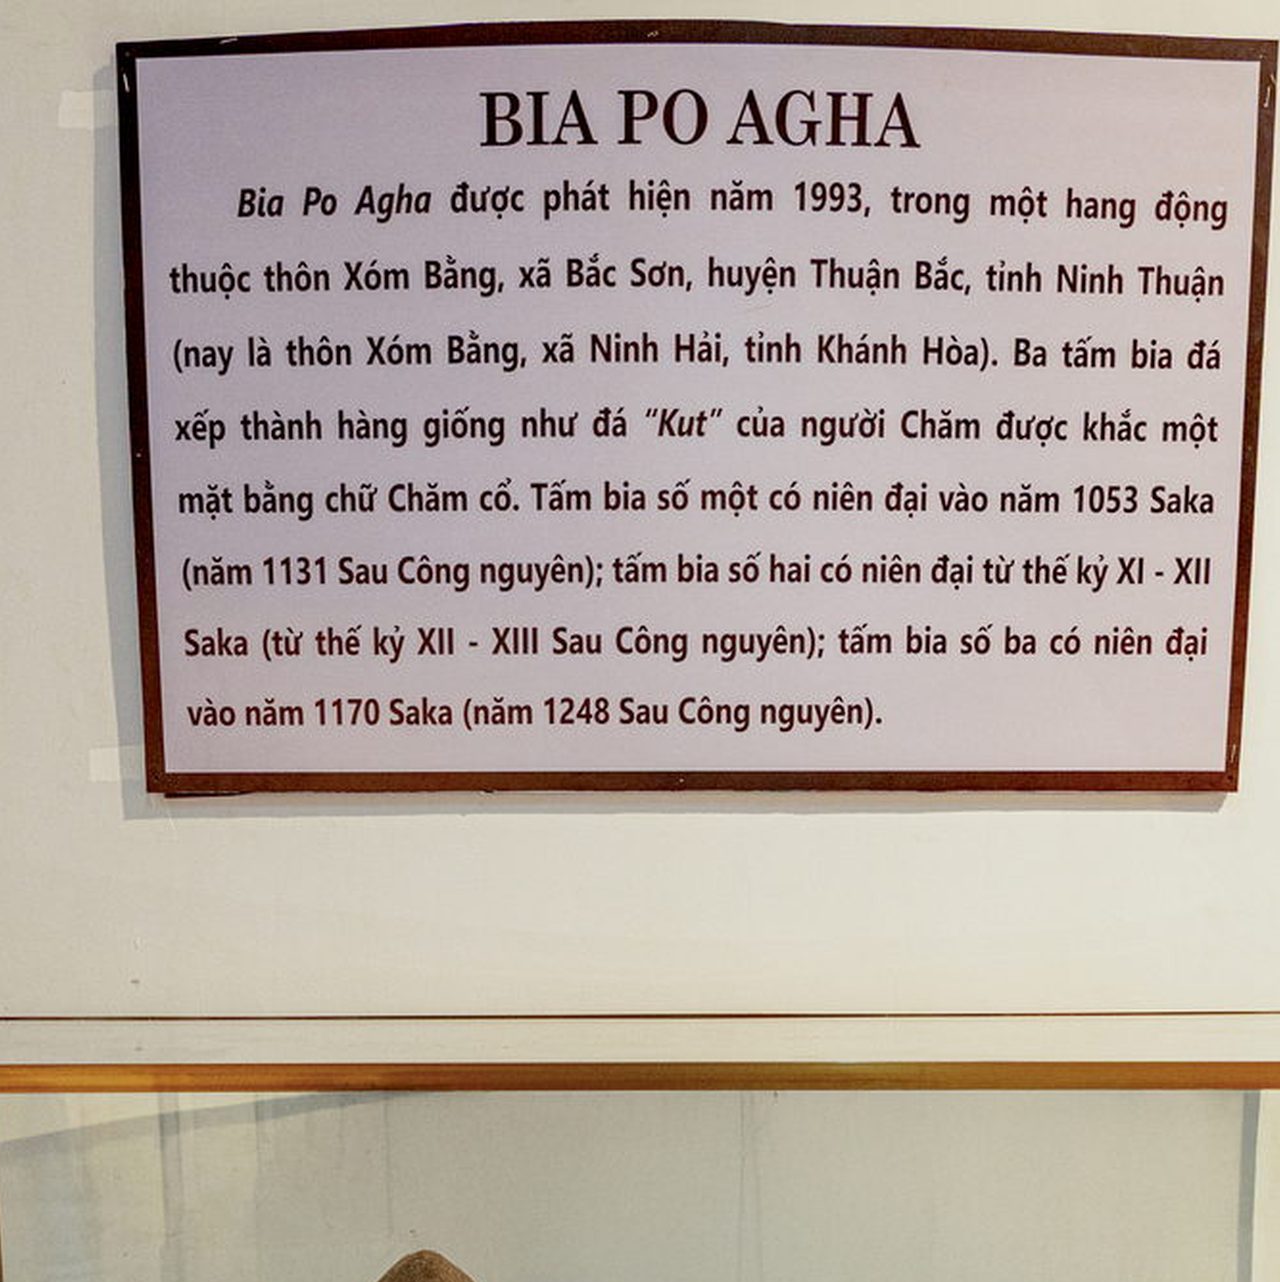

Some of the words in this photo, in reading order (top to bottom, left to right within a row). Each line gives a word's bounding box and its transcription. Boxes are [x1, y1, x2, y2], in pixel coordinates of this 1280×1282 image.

[477, 88, 600, 149] BIA
[615, 87, 710, 147] PO
[724, 87, 923, 150] AGHA
[235, 184, 286, 220] Bia
[301, 184, 339, 218] Po
[352, 181, 433, 226] Agha
[448, 179, 526, 221] được
[542, 178, 612, 222] phát
[627, 177, 692, 220] hiện
[709, 178, 774, 213] năm
[793, 179, 872, 219] 1993,
[889, 184, 971, 226] trong
[988, 184, 1049, 226] một
[1065, 186, 1137, 230] hang
[1153, 188, 1229, 232] động
[167, 260, 253, 302] thuộc
[261, 259, 332, 294] thôn
[342, 257, 411, 293] Xóm
[423, 253, 506, 299] Bằng,
[517, 256, 553, 290] xã
[565, 251, 618, 289] Bắc
[629, 256, 694, 294] Sơn,
[707, 254, 797, 298] huyện
[808, 255, 901, 298] Thuận
[914, 254, 972, 297] Bắc,
[984, 258, 1043, 294] tỉnh
[1055, 262, 1125, 296] Ninh
[1136, 263, 1225, 304] Thuận
[172, 337, 236, 378] (nay
[246, 334, 273, 369] là
[283, 333, 354, 368] thôn
[364, 332, 433, 367] Xóm
[446, 328, 528, 374] Bằng,
[540, 331, 576, 365] xã
[589, 330, 660, 364] Ninh
[673, 329, 730, 369] Hải,
[743, 329, 803, 365] tỉnh
[816, 331, 908, 366] Khánh
[922, 333, 999, 373] Hòa).
[1012, 336, 1048, 369] Ba
[1060, 334, 1117, 370] tấm
[1130, 337, 1174, 371] bia
[1186, 338, 1222, 371] đá
[173, 406, 228, 451] xếp
[238, 408, 324, 442] thành
[336, 407, 409, 450] hàng
[422, 404, 506, 449] giống
[520, 405, 580, 439] như
[591, 405, 628, 439] đá
[735, 404, 786, 439] của
[800, 406, 886, 448] người
[899, 407, 982, 441] Chăm
[995, 408, 1069, 449] được
[1081, 407, 1149, 443] khắc
[1161, 411, 1220, 451] một
[177, 482, 235, 522] mặt
[242, 478, 315, 523] bằng
[323, 481, 380, 515] chữ
[386, 480, 469, 514] Chăm
[478, 475, 521, 513] cổ.
[528, 477, 593, 513] Tấm
[602, 479, 647, 513] bia
[656, 477, 692, 512] số
[699, 479, 760, 519] một
[767, 479, 803, 512] có
[812, 480, 874, 513] niên
[883, 480, 929, 520] đại
[937, 481, 990, 514] vào
[999, 482, 1061, 514] năm
[1072, 483, 1139, 515] 1053
[1149, 483, 1215, 515] Saka
[181, 554, 254, 593] (năm
[261, 554, 327, 587] 1131
[337, 555, 389, 587] Sau
[396, 553, 471, 594] Công
[478, 552, 604, 594] nguyên);
[610, 550, 668, 585] tấm
[676, 551, 720, 584] bia
[727, 550, 763, 585] số
[768, 551, 812, 584] hai
[819, 552, 854, 585] có
[861, 552, 922, 585] niên
[930, 553, 975, 592] đại
[981, 553, 1017, 586] từ
[1020, 552, 1072, 586] thế
[1075, 553, 1110, 594] kỷ
[1115, 555, 1146, 586] XI
[1172, 556, 1212, 586] XII
[183, 625, 250, 659] Saka
[261, 625, 305, 664] (từ
[313, 623, 364, 658] thế
[372, 623, 407, 665] kỷ
[416, 626, 455, 657] XII
[490, 625, 540, 656] XIII
[551, 625, 603, 656] Sau
[614, 623, 689, 664] Công
[701, 623, 826, 664] nguyên);
[836, 622, 893, 656] tấm
[905, 623, 948, 656] bia
[959, 622, 994, 656] số
[1003, 624, 1038, 656] ba
[1048, 624, 1082, 656] có
[1093, 625, 1153, 657] niên
[1164, 625, 1209, 663] đại
[185, 696, 238, 728] vào
[243, 696, 306, 728] năm
[313, 696, 382, 727] 1170
[388, 695, 454, 727] Saka
[462, 695, 534, 733] (năm
[542, 695, 611, 726] 1248
[618, 695, 670, 726] Sau
[677, 694, 751, 734] Công
[759, 694, 884, 734] nguyên).
